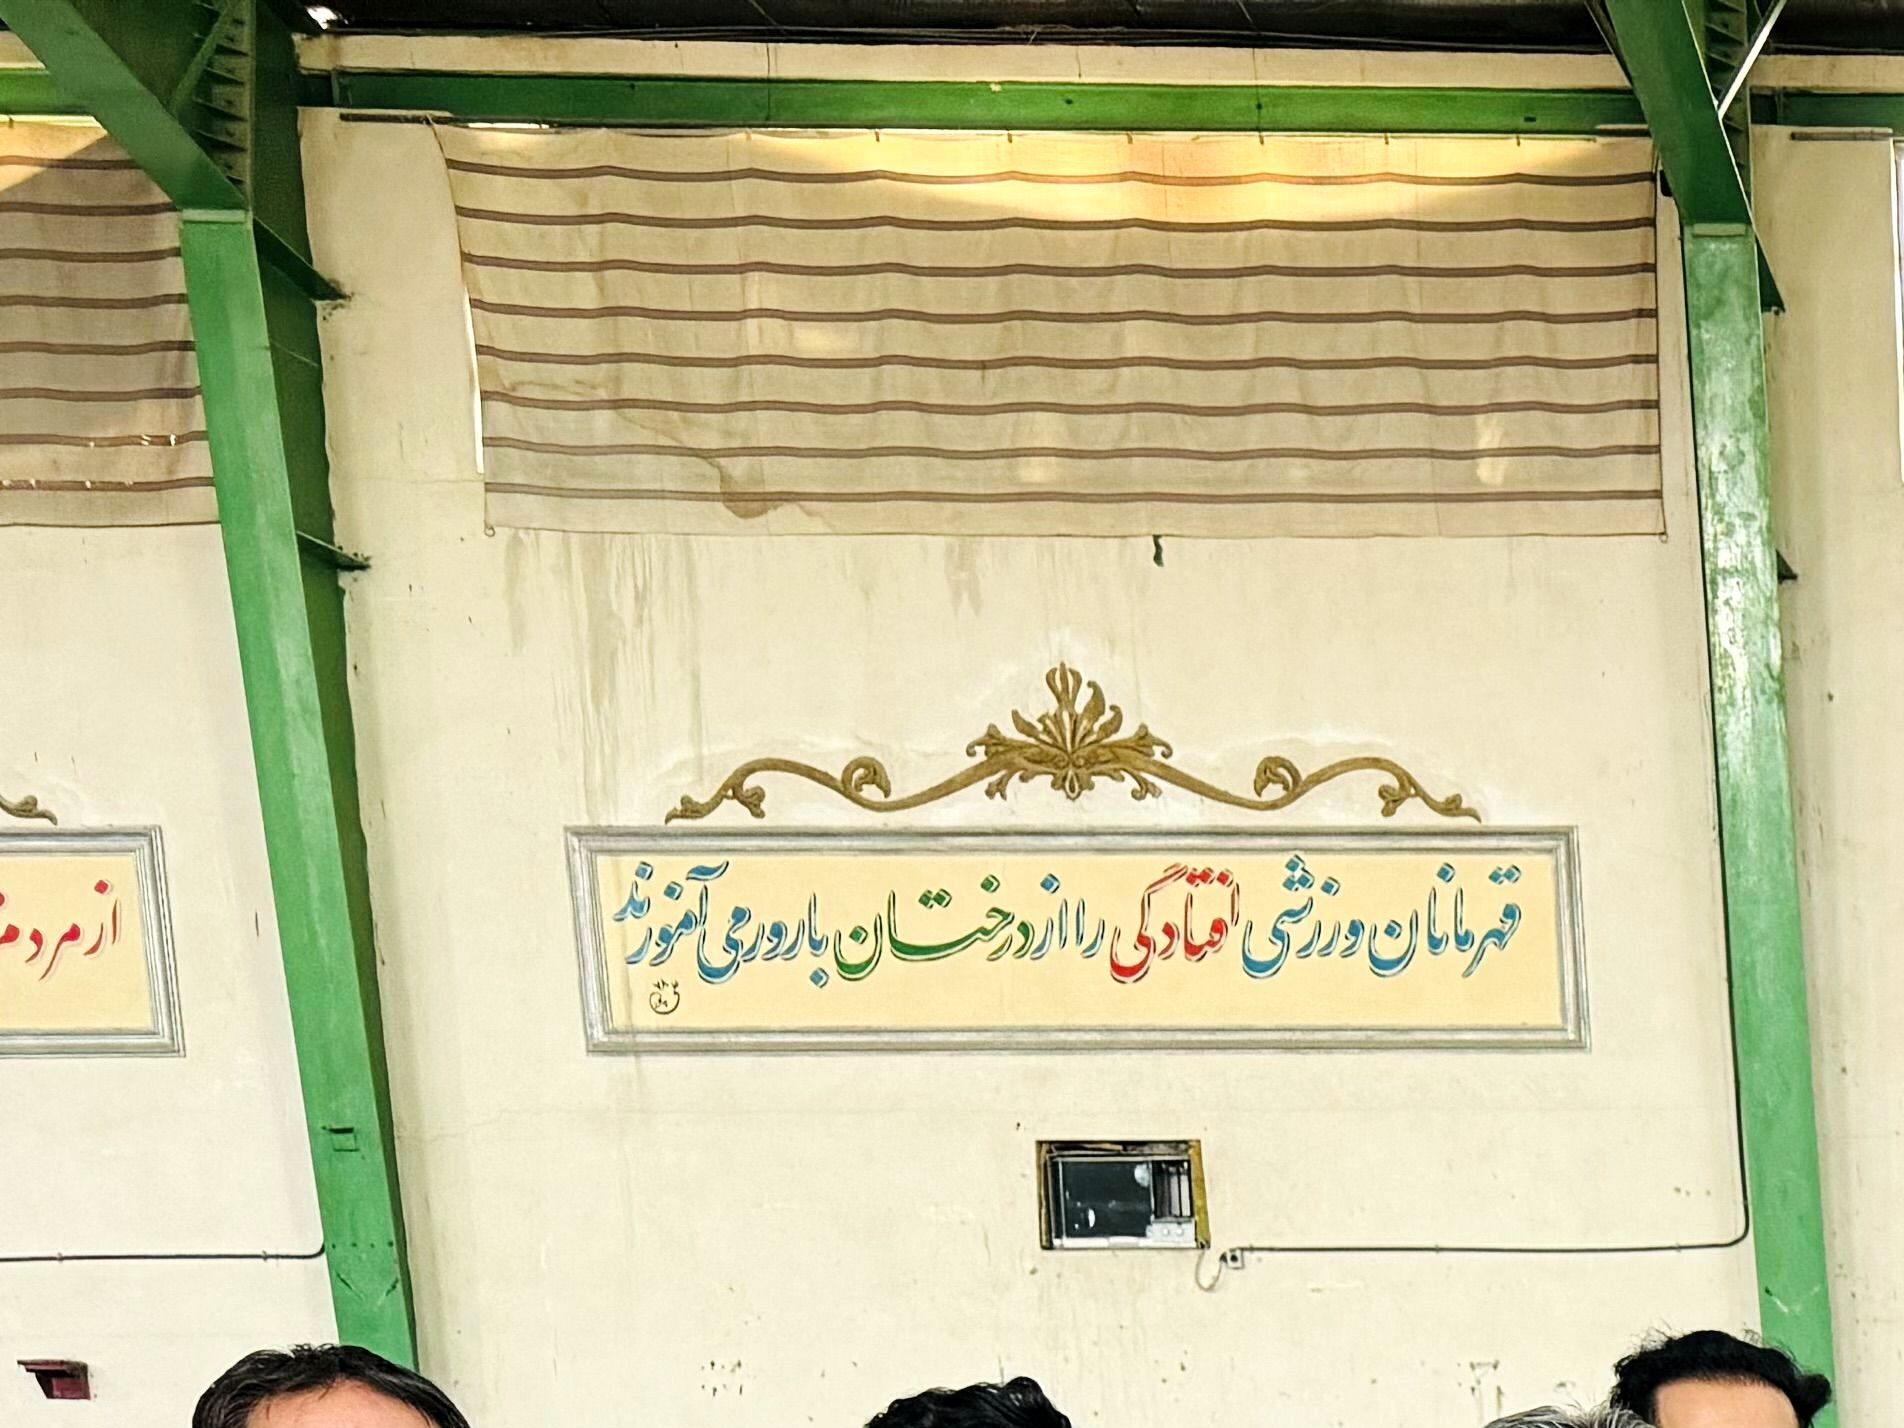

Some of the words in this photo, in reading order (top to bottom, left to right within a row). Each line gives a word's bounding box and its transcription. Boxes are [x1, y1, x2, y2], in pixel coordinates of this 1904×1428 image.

[741, 890, 829, 988] بارور
[833, 873, 1036, 982] درختان
[1030, 873, 1069, 961] از
[1075, 897, 1106, 959] را
[1110, 862, 1241, 984] افتادگی
[1242, 854, 1365, 980] ورزشی
[1367, 862, 1522, 979] قهرمانان
